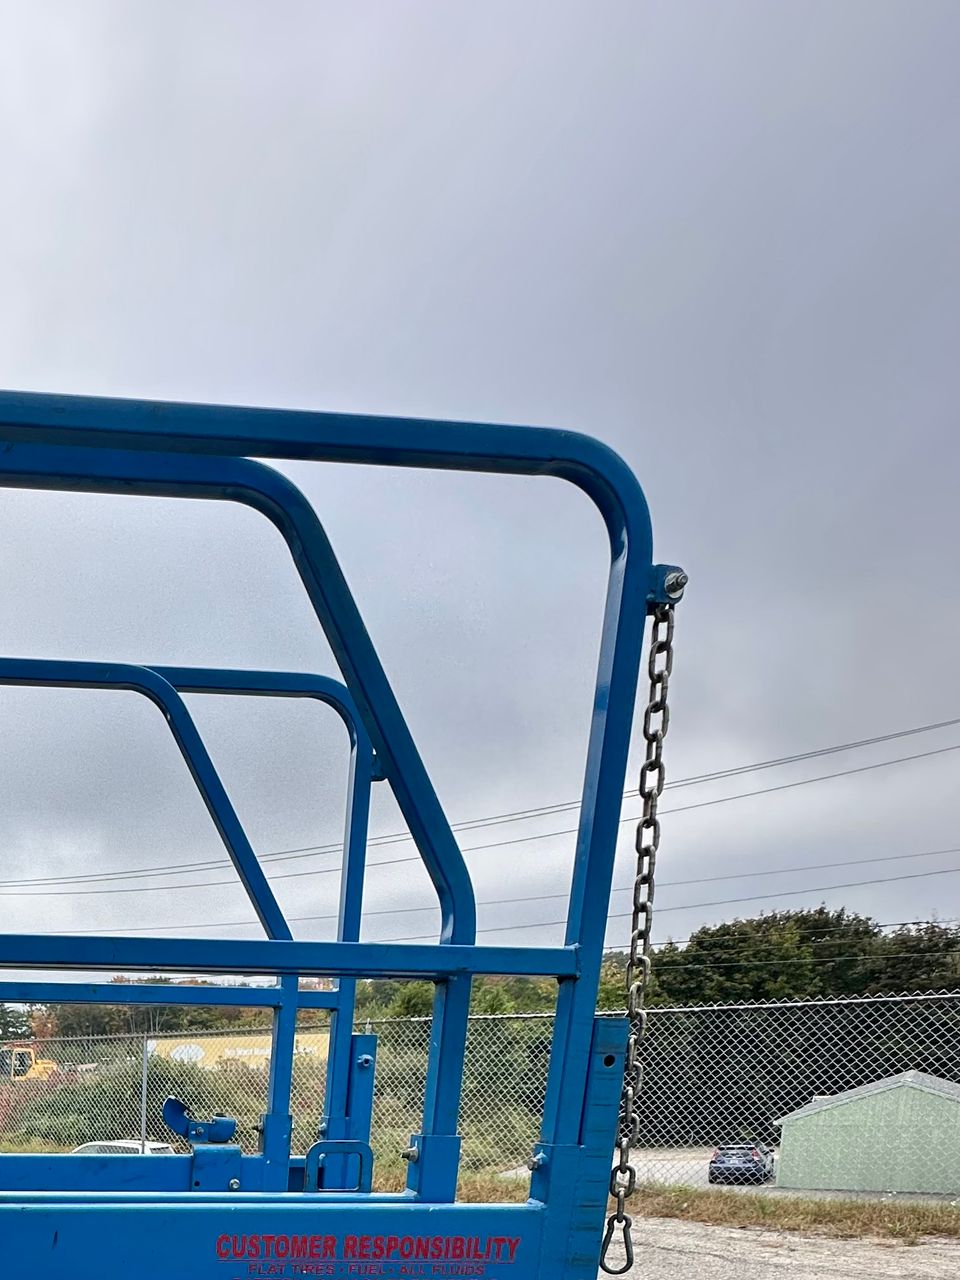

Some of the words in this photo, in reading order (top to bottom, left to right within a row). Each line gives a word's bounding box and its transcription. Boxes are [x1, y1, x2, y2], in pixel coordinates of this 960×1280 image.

[216, 1234, 337, 1258] CUSTOMER
[343, 1234, 521, 1259] RESPONSIBILITY
[248, 1264, 286, 1274] FLAT
[292, 1264, 335, 1275] TIRES
[348, 1264, 385, 1275] FUEL
[400, 1264, 425, 1275] ALL
[432, 1264, 484, 1276] FLUIDS
